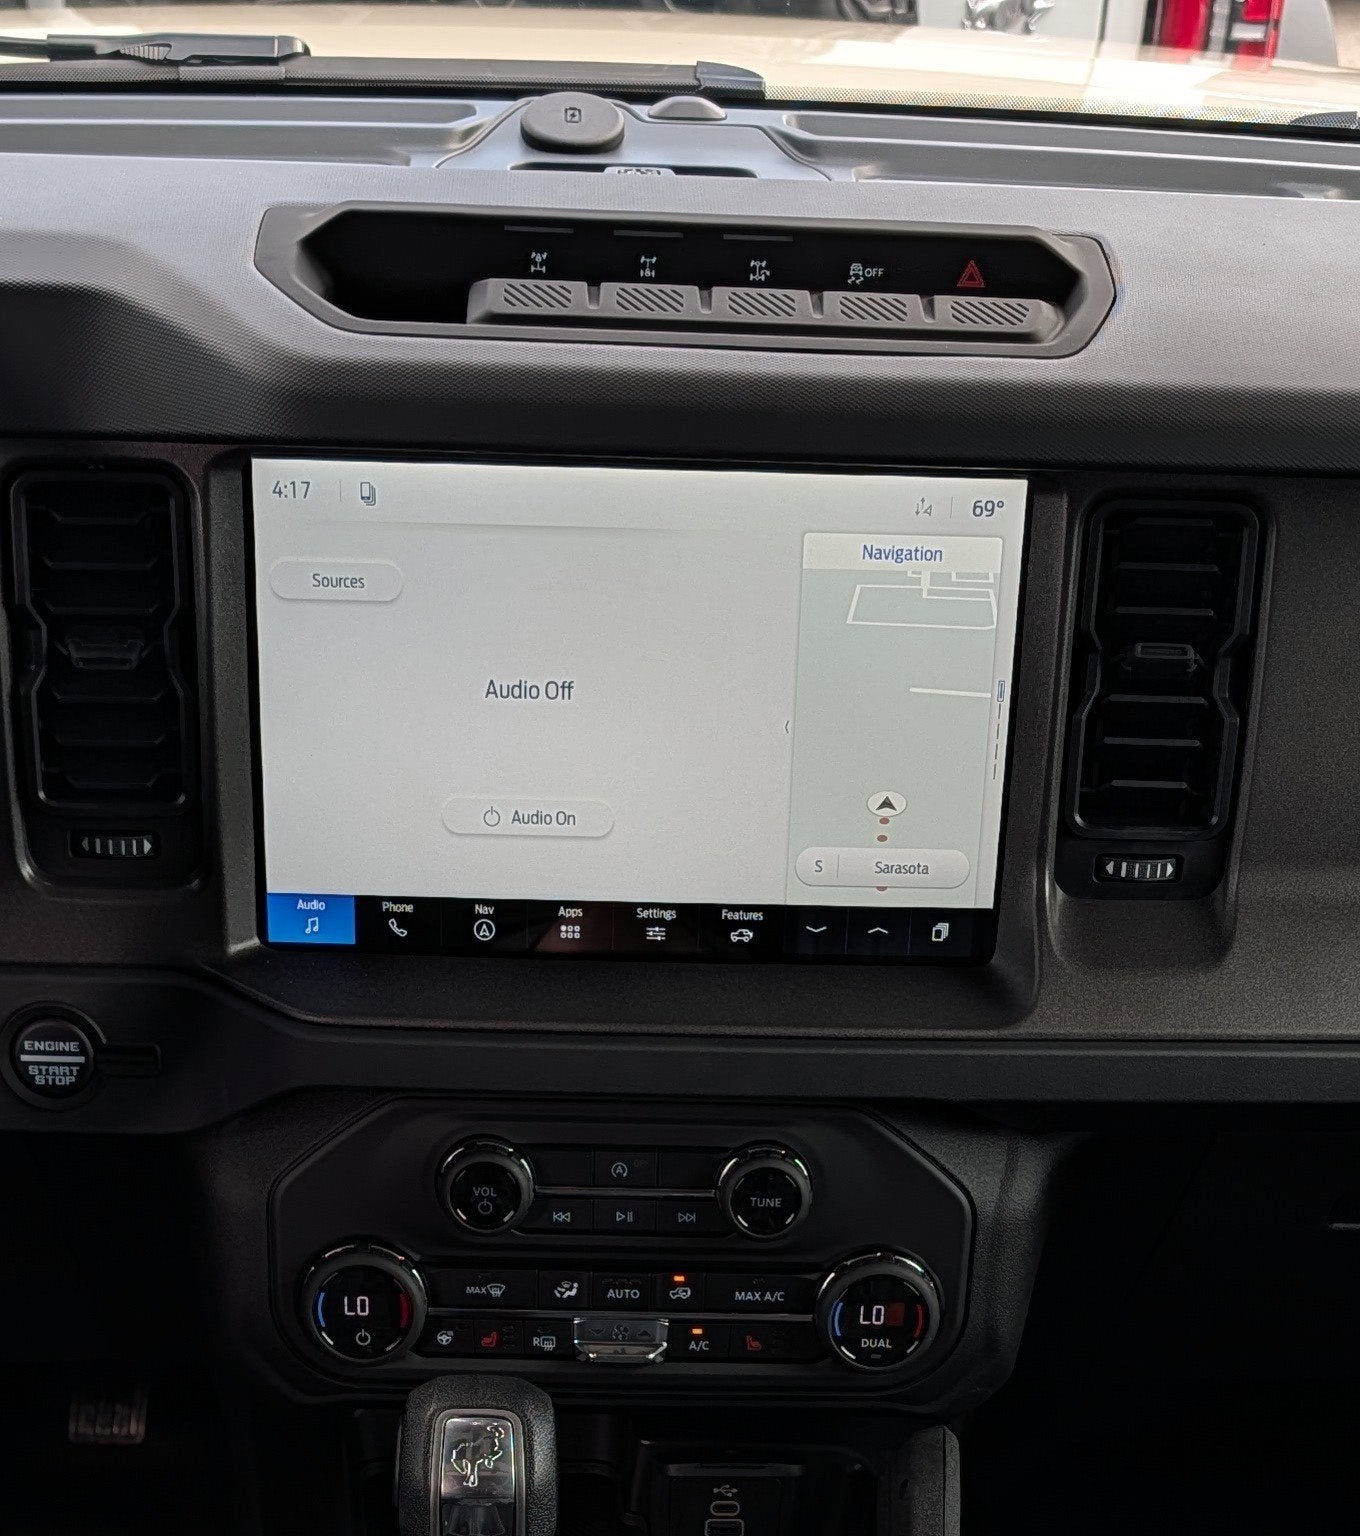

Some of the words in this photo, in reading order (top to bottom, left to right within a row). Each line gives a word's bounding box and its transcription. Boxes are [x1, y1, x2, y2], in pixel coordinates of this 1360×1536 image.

[865, 268, 884, 277] OFF
[271, 480, 311, 499] 4:17
[972, 500, 1005, 517] 69°
[862, 544, 943, 563] Navigation
[312, 573, 365, 589] Sources
[485, 679, 540, 700] Audio
[545, 680, 574, 700] Off
[511, 809, 552, 825] Audio
[556, 810, 576, 826] On
[814, 859, 823, 873] S
[874, 861, 929, 875] Sarasota
[297, 899, 325, 911] Audio
[382, 901, 414, 913] Phone
[474, 904, 494, 915] Nav
[558, 906, 583, 919] Apps
[636, 907, 677, 920] Settings
[722, 909, 764, 921] Features
[24, 1041, 80, 1052] ENGINE
[28, 1065, 80, 1076] START
[35, 1075, 76, 1085] STOP
[472, 1186, 497, 1197] VOL
[750, 1197, 782, 1208] TUNE
[466, 1286, 487, 1295] MAX
[607, 1289, 640, 1299] AUTO
[735, 1291, 761, 1301] MAX
[764, 1291, 785, 1302] A/C
[343, 1296, 369, 1316] LO
[860, 1305, 885, 1325] LO
[689, 1340, 709, 1351] A/C
[861, 1338, 892, 1348] DUAL
